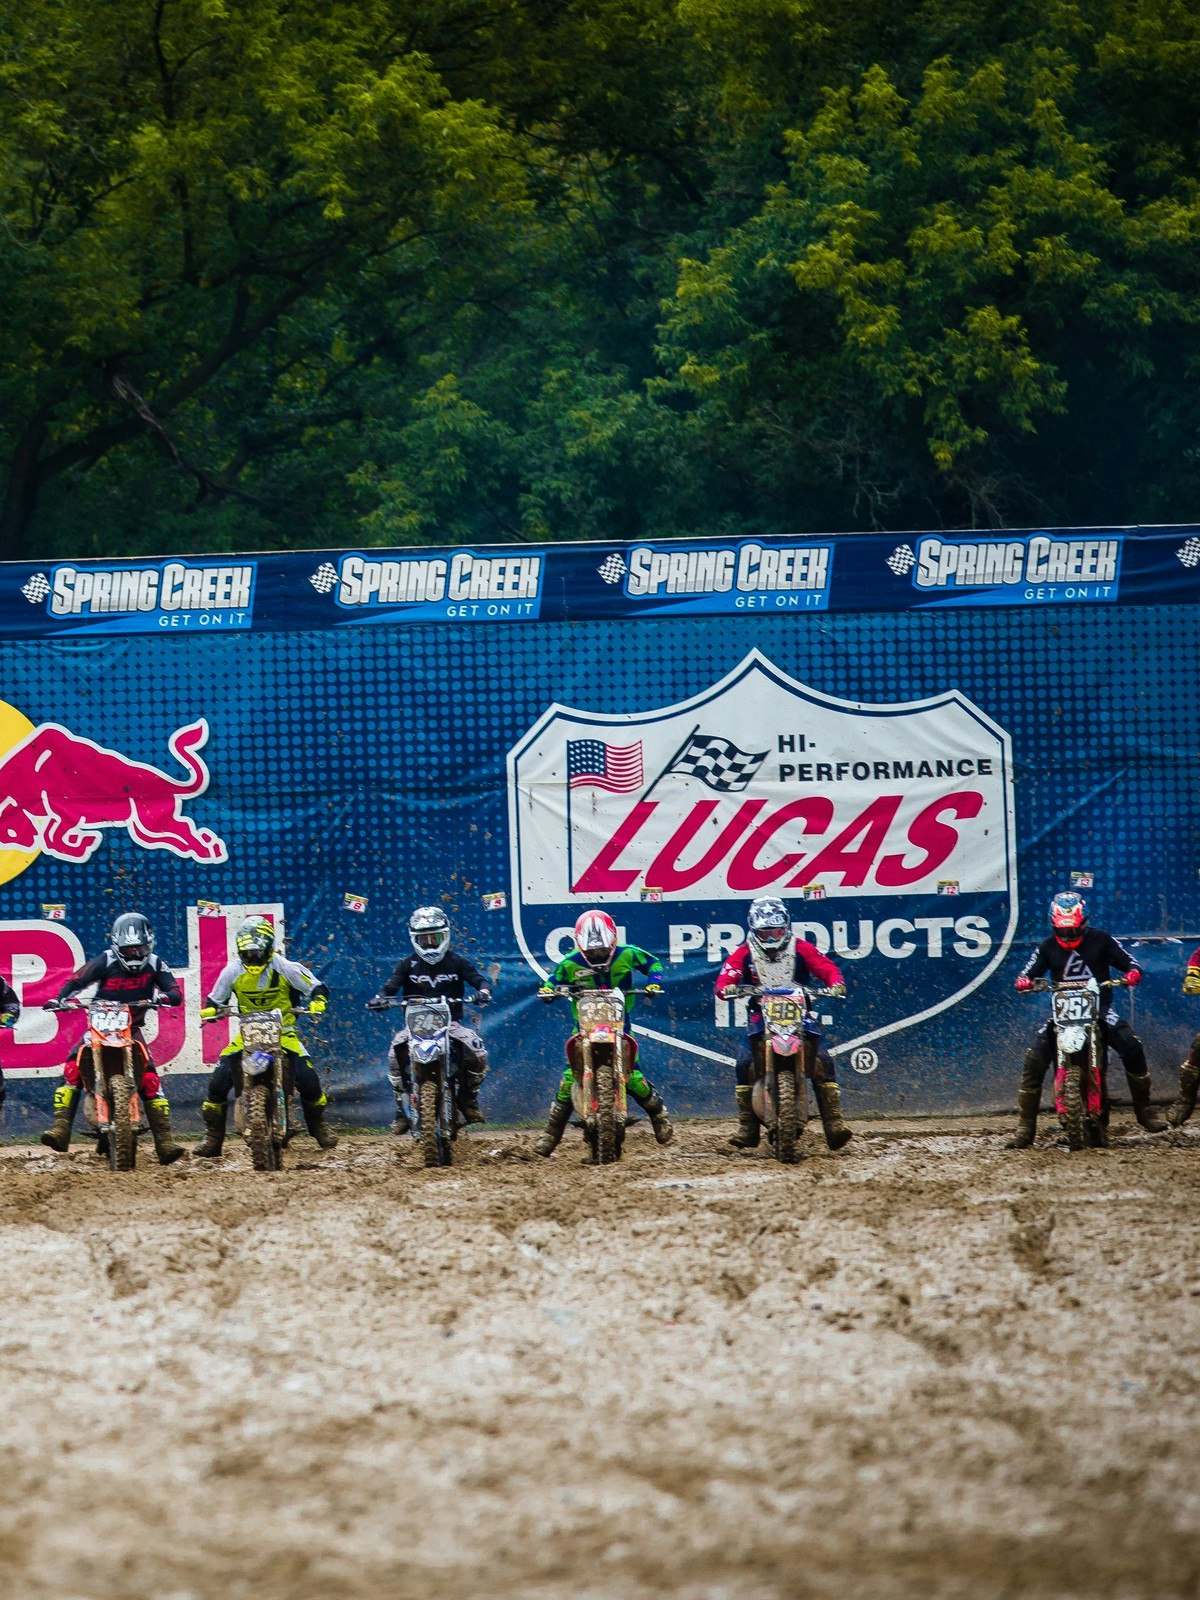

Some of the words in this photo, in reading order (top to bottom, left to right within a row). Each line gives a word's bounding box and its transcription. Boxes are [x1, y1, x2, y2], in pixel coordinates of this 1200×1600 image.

[338, 556, 447, 605] SPRING
[448, 553, 540, 601] CREEK
[627, 547, 736, 596] SPRING
[736, 543, 829, 592] CREEK
[916, 539, 1025, 587] SPRING
[1025, 536, 1118, 584] CREEK
[51, 567, 159, 615] SPRING
[160, 563, 253, 611] CREEK
[735, 595, 768, 607] GET
[775, 595, 799, 606] ON
[806, 594, 822, 605] IT
[1024, 587, 1057, 600] GET
[1064, 587, 1088, 598] ON
[1095, 586, 1112, 597] IT
[158, 614, 191, 627] GET
[199, 614, 222, 626] ON
[229, 613, 246, 624] IT
[446, 605, 479, 617] GET
[487, 604, 510, 615] ON
[517, 603, 534, 614] IT
[777, 734, 816, 753] HI-
[778, 758, 993, 783] PERFORMANCE
[570, 791, 984, 893] LUCAS
[668, 915, 992, 963] PRDUCTS
